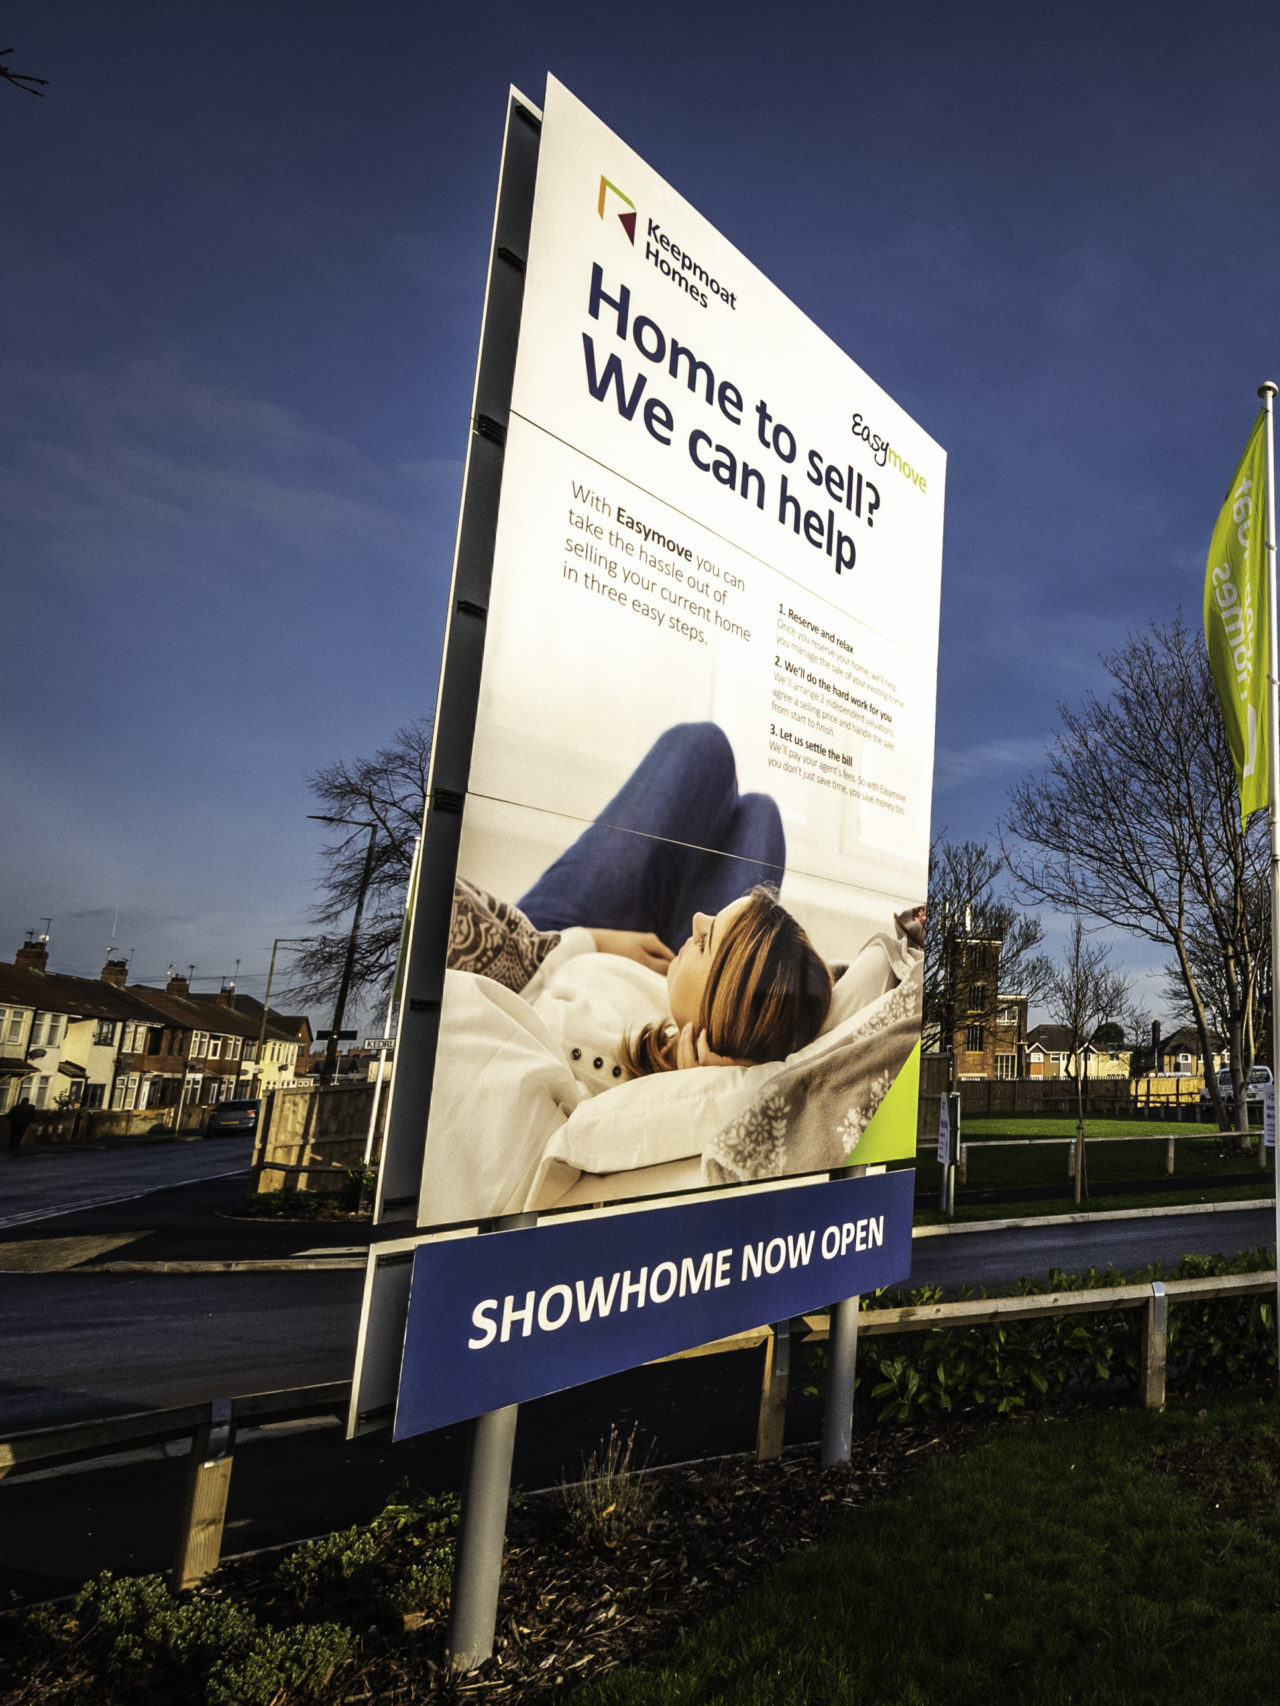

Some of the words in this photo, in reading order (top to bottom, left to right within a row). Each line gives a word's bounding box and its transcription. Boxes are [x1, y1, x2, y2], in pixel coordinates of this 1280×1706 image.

[645, 241, 708, 308] Homes
[647, 217, 737, 310] Keepmoat
[588, 261, 743, 425] Home
[755, 400, 796, 463] to
[807, 449, 881, 527] sell?
[581, 332, 674, 446] We
[689, 429, 765, 510] can
[779, 474, 856, 575] help
[852, 413, 927, 493] Easymove
[568, 508, 603, 540] take
[608, 530, 634, 556] the
[639, 544, 683, 582] hassle
[687, 576, 710, 597] out
[713, 590, 727, 604] of
[571, 480, 612, 517] With
[616, 506, 693, 562] Easymove
[696, 555, 720, 579] you
[723, 571, 745, 592] can
[563, 561, 578, 584] in
[584, 572, 628, 606] three
[631, 597, 666, 627] easy
[668, 616, 708, 645] steps.
[564, 538, 618, 578] selling
[622, 566, 657, 593] your
[660, 587, 712, 623] current
[714, 610, 751, 642] home
[776, 635, 790, 648] you
[819, 657, 831, 670] the
[779, 603, 786, 616] 1.
[788, 608, 819, 634] Reserve
[821, 630, 835, 643] and
[836, 638, 854, 654] relax
[797, 632, 810, 644] you
[771, 700, 790, 717] from
[791, 711, 806, 725] start
[807, 718, 815, 728] to
[774, 655, 782, 668] 2.
[784, 660, 805, 679] We'll
[807, 672, 817, 685] do
[819, 678, 831, 692] the
[833, 684, 849, 701] hard
[850, 696, 868, 711] work
[869, 703, 879, 716] for
[880, 710, 892, 723] you
[767, 757, 782, 769] you
[802, 769, 815, 782] just
[816, 776, 831, 787] save
[849, 788, 861, 799] you
[770, 723, 778, 736] 3.
[780, 728, 792, 742] Let
[794, 736, 803, 747] us
[805, 740, 827, 756] settle
[828, 749, 841, 762] the
[841, 753, 853, 767] bill
[789, 750, 801, 762] pay
[802, 755, 818, 766] your
[858, 775, 866, 787] So
[468, 1248, 732, 1350] SHOWHOME
[741, 1229, 816, 1282] NOW
[821, 1215, 885, 1260] OPEN
